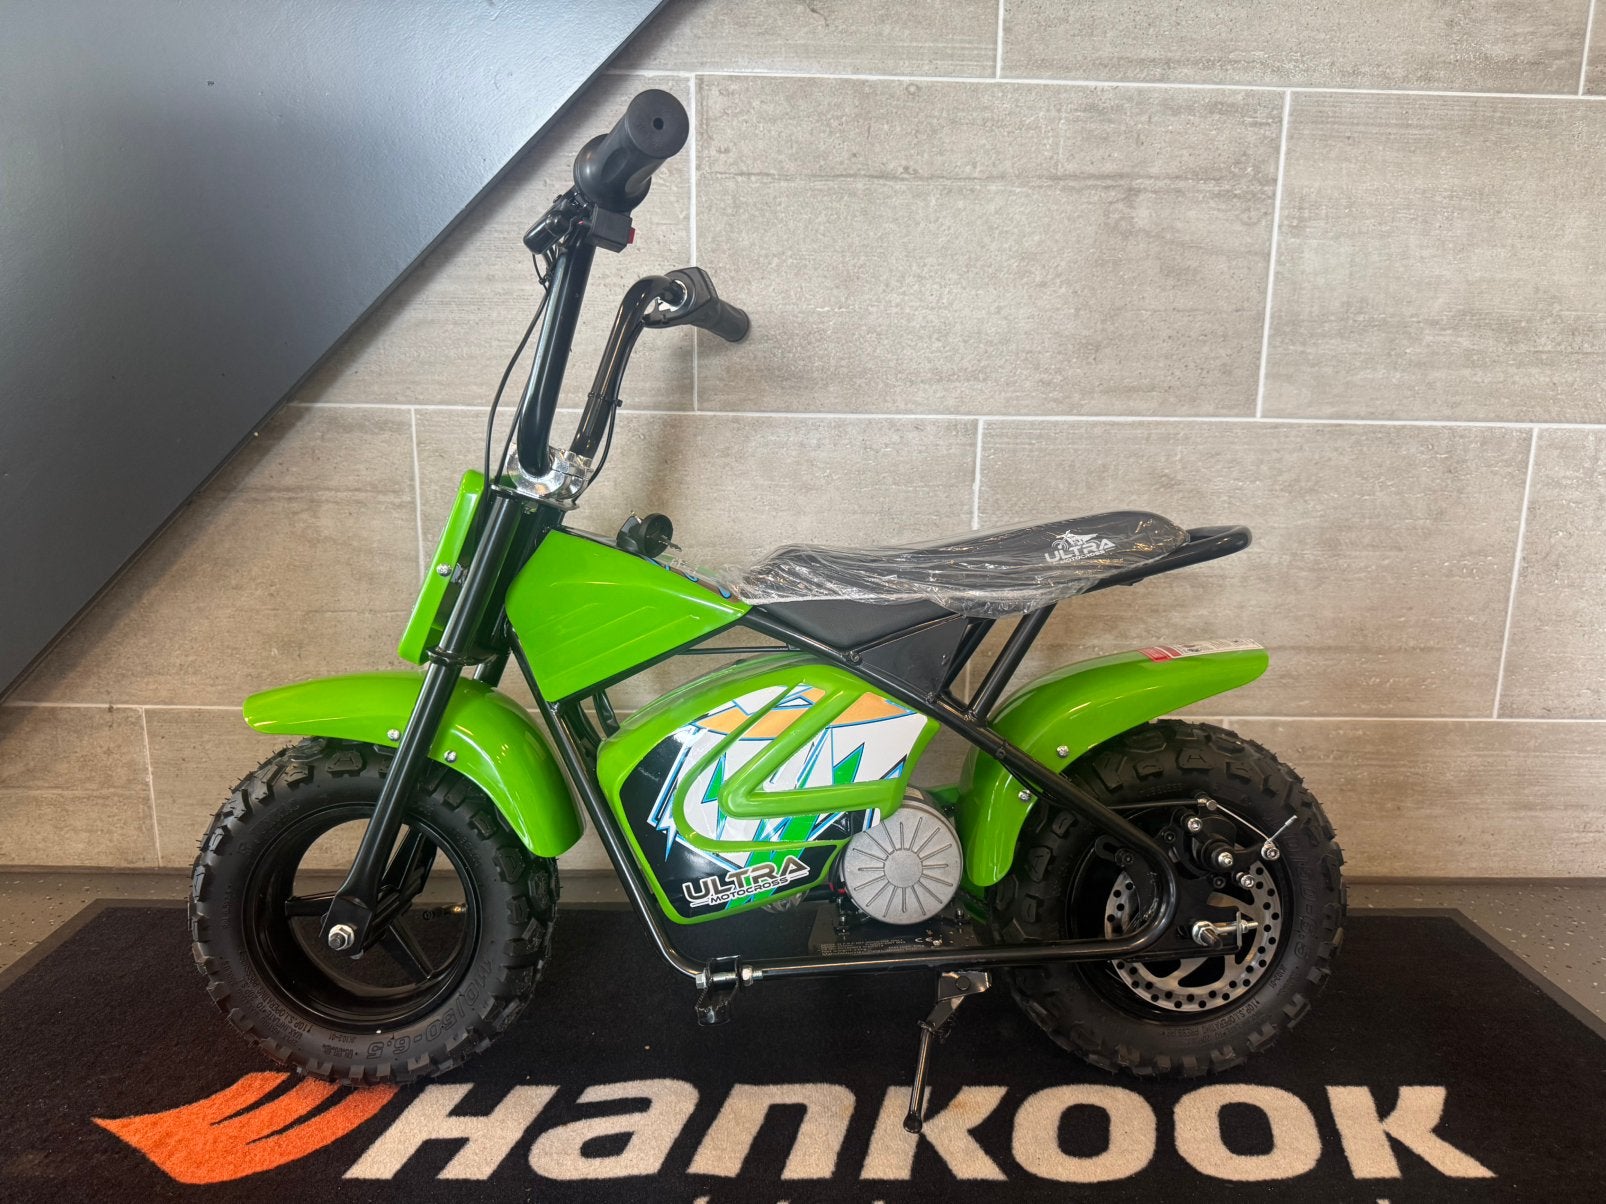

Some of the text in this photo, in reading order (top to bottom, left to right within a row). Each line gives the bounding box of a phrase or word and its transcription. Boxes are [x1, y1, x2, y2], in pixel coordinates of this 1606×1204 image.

[1044, 538, 1117, 562] ULTRA
[683, 855, 810, 900] ULTRA
[709, 876, 790, 905] MOTOCROSS
